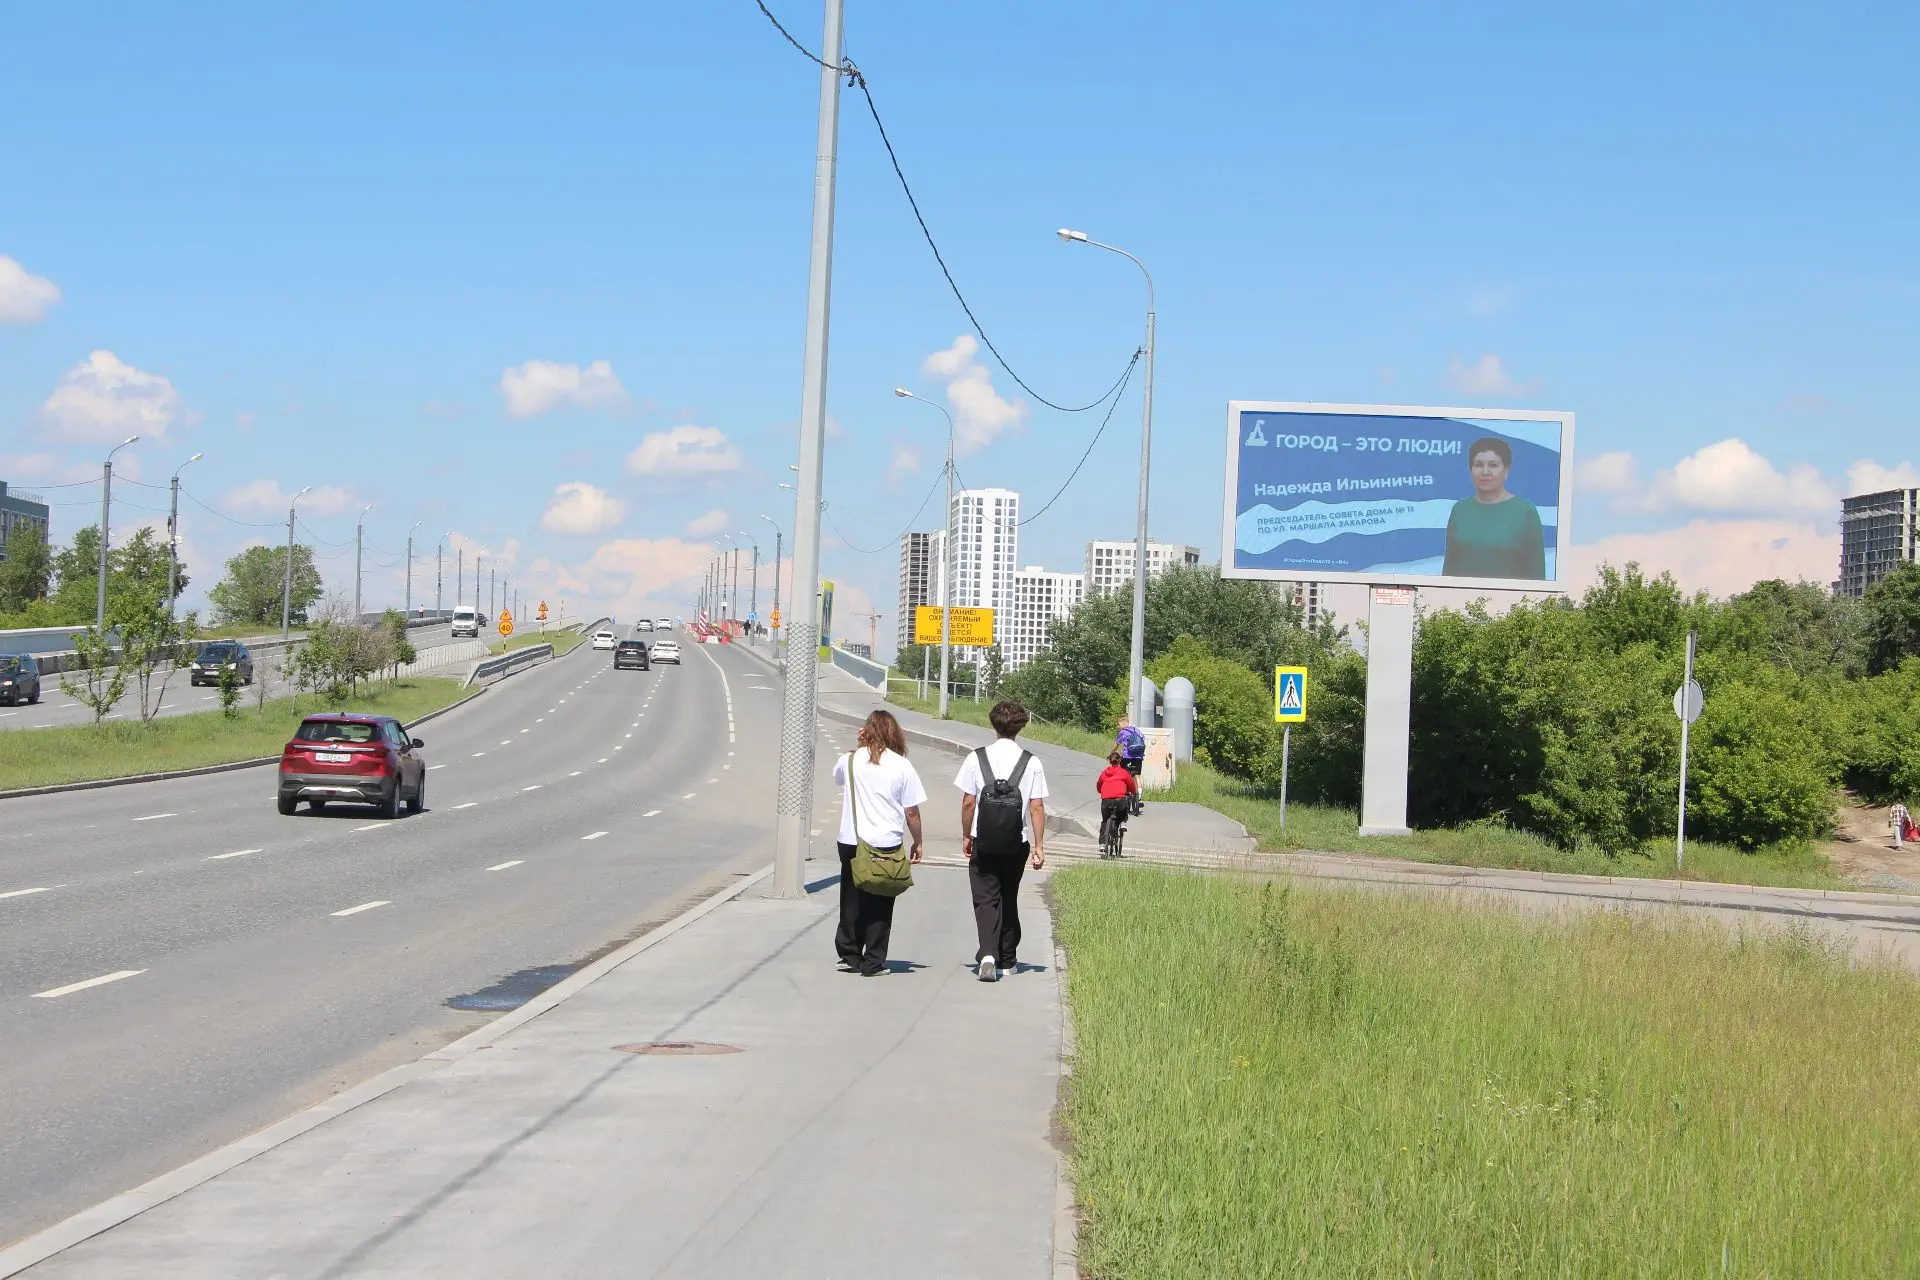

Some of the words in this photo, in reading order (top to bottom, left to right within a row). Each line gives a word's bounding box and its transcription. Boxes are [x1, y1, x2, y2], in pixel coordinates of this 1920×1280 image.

[1276, 434, 1338, 452] ГОРОД
[1356, 437, 1392, 452] ЭТО
[1397, 438, 1462, 456] ЛЮДИ!
[1254, 480, 1332, 497] Надежда
[1337, 474, 1434, 491] Ильинична
[1257, 513, 1327, 525] ПРЕДСЕДАТЕЛЬ
[1329, 510, 1364, 519] СОВЕТА
[1366, 508, 1393, 517] ДОМА
[1274, 525, 1287, 533] УЛ.
[1290, 521, 1336, 531] МАРШАЛА
[1339, 517, 1386, 527] ЗАХАРОВА
[933, 608, 977, 616] ВНМАНИЕ!
[928, 614, 981, 623] ОХРНЯЕМЫЙ
[501, 624, 511, 632] 40
[936, 628, 972, 636] ВЕТСЯ
[919, 634, 988, 644] ВИДЕОБЛЮДЕНИЕ
